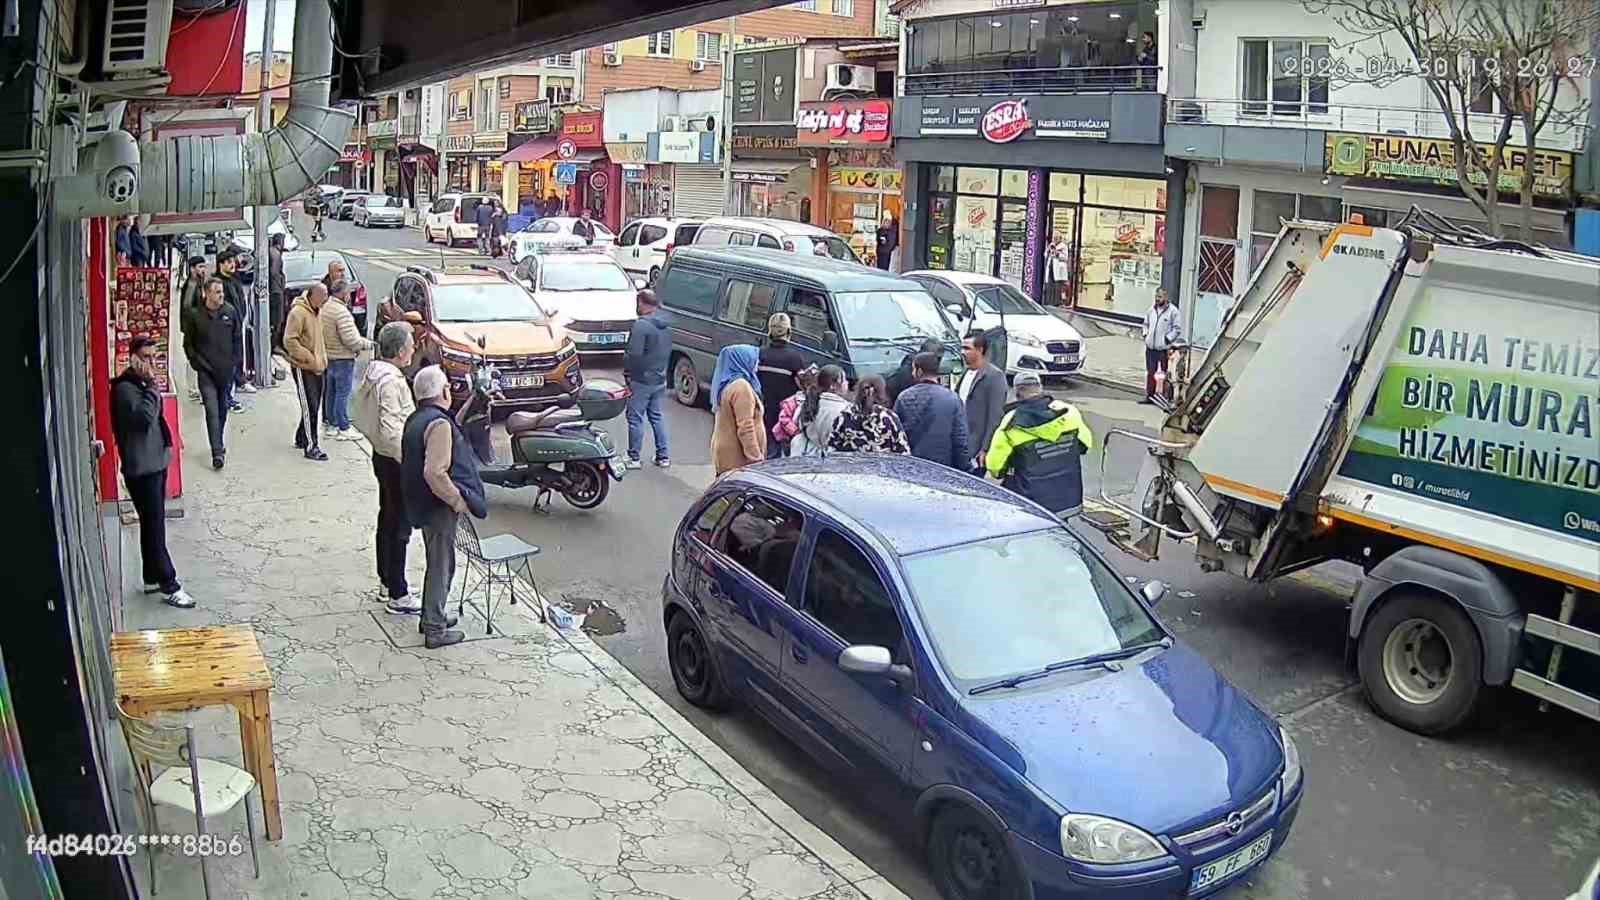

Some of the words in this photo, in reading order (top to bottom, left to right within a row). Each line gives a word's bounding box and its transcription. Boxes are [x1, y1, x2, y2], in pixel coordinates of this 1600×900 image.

[986, 102, 1022, 131] ESRA
[1370, 137, 1441, 162] TUNA
[1408, 326, 1488, 365] DAHA
[1504, 337, 1600, 379] TEMİZ
[1402, 374, 1454, 412] BİR
[1466, 379, 1600, 438] MURA
[1399, 425, 1600, 491] HİZMETİNİZD
[1199, 865, 1216, 884] 59
[1224, 852, 1242, 873] FF
